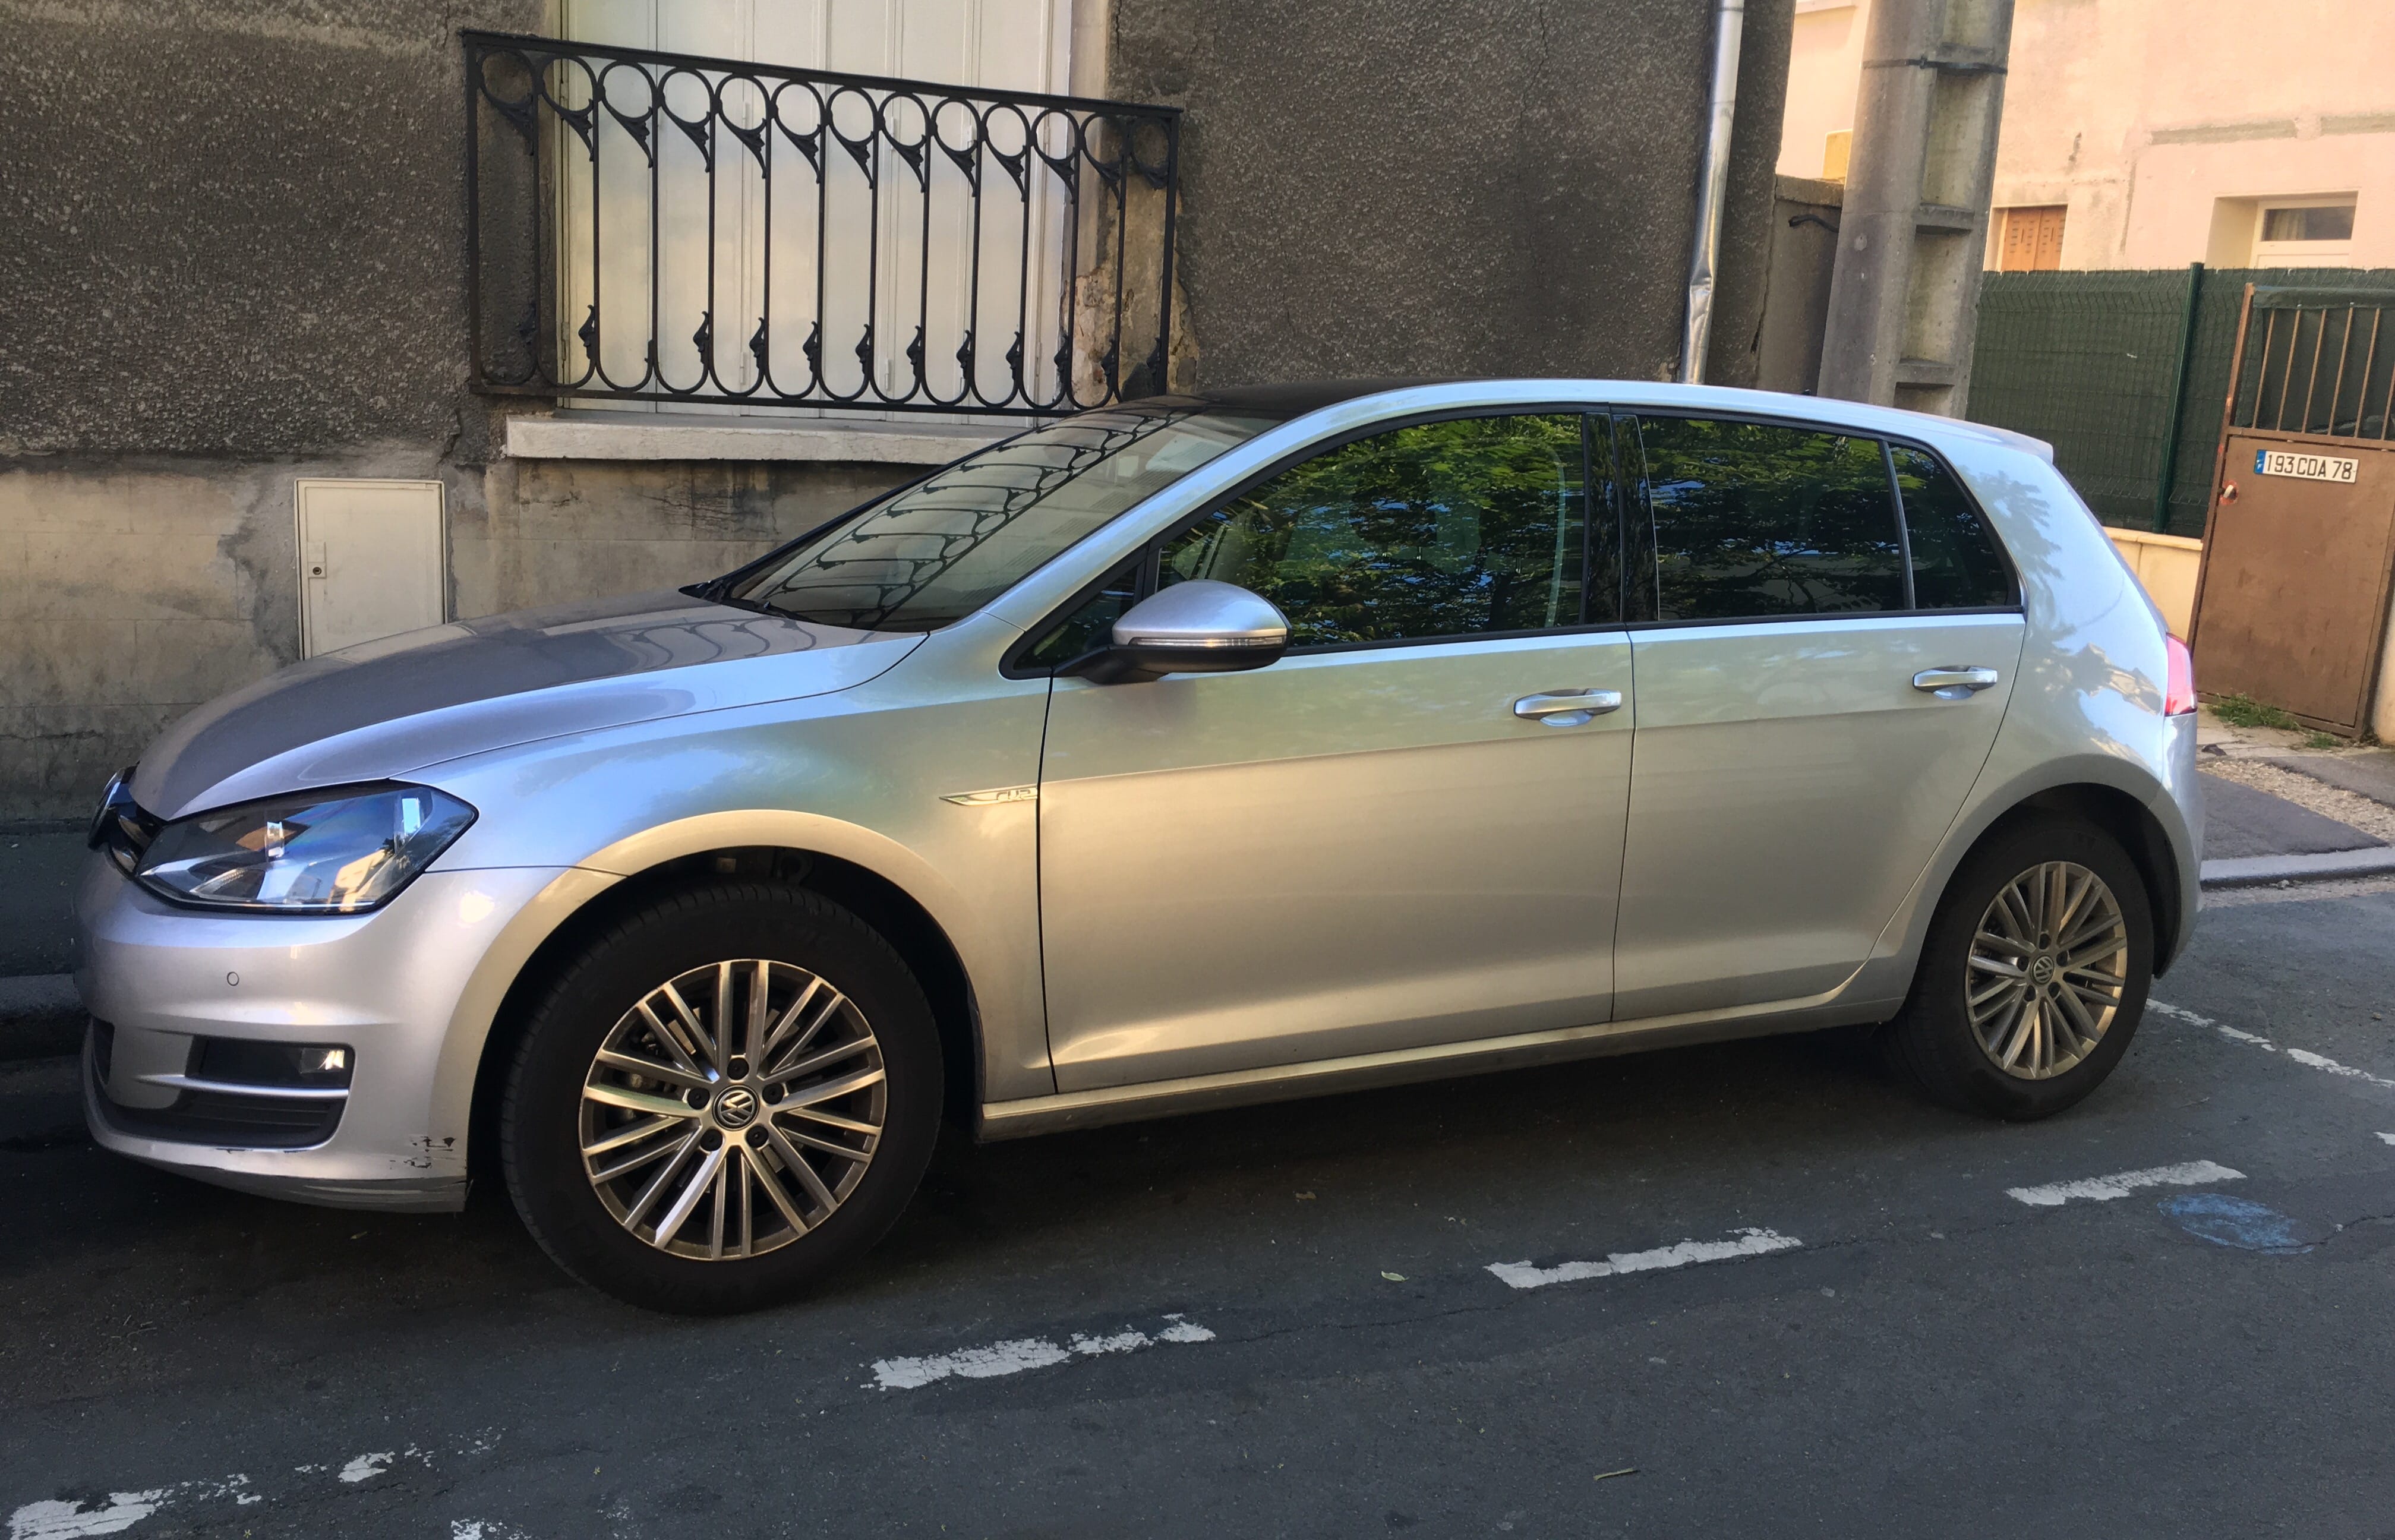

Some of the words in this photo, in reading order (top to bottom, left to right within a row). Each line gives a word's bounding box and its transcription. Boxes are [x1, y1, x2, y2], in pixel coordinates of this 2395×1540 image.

[2267, 455, 2295, 474] 193
[2296, 457, 2327, 478] CDA
[2332, 460, 2353, 480] 78
[718, 1090, 755, 1125] VW
